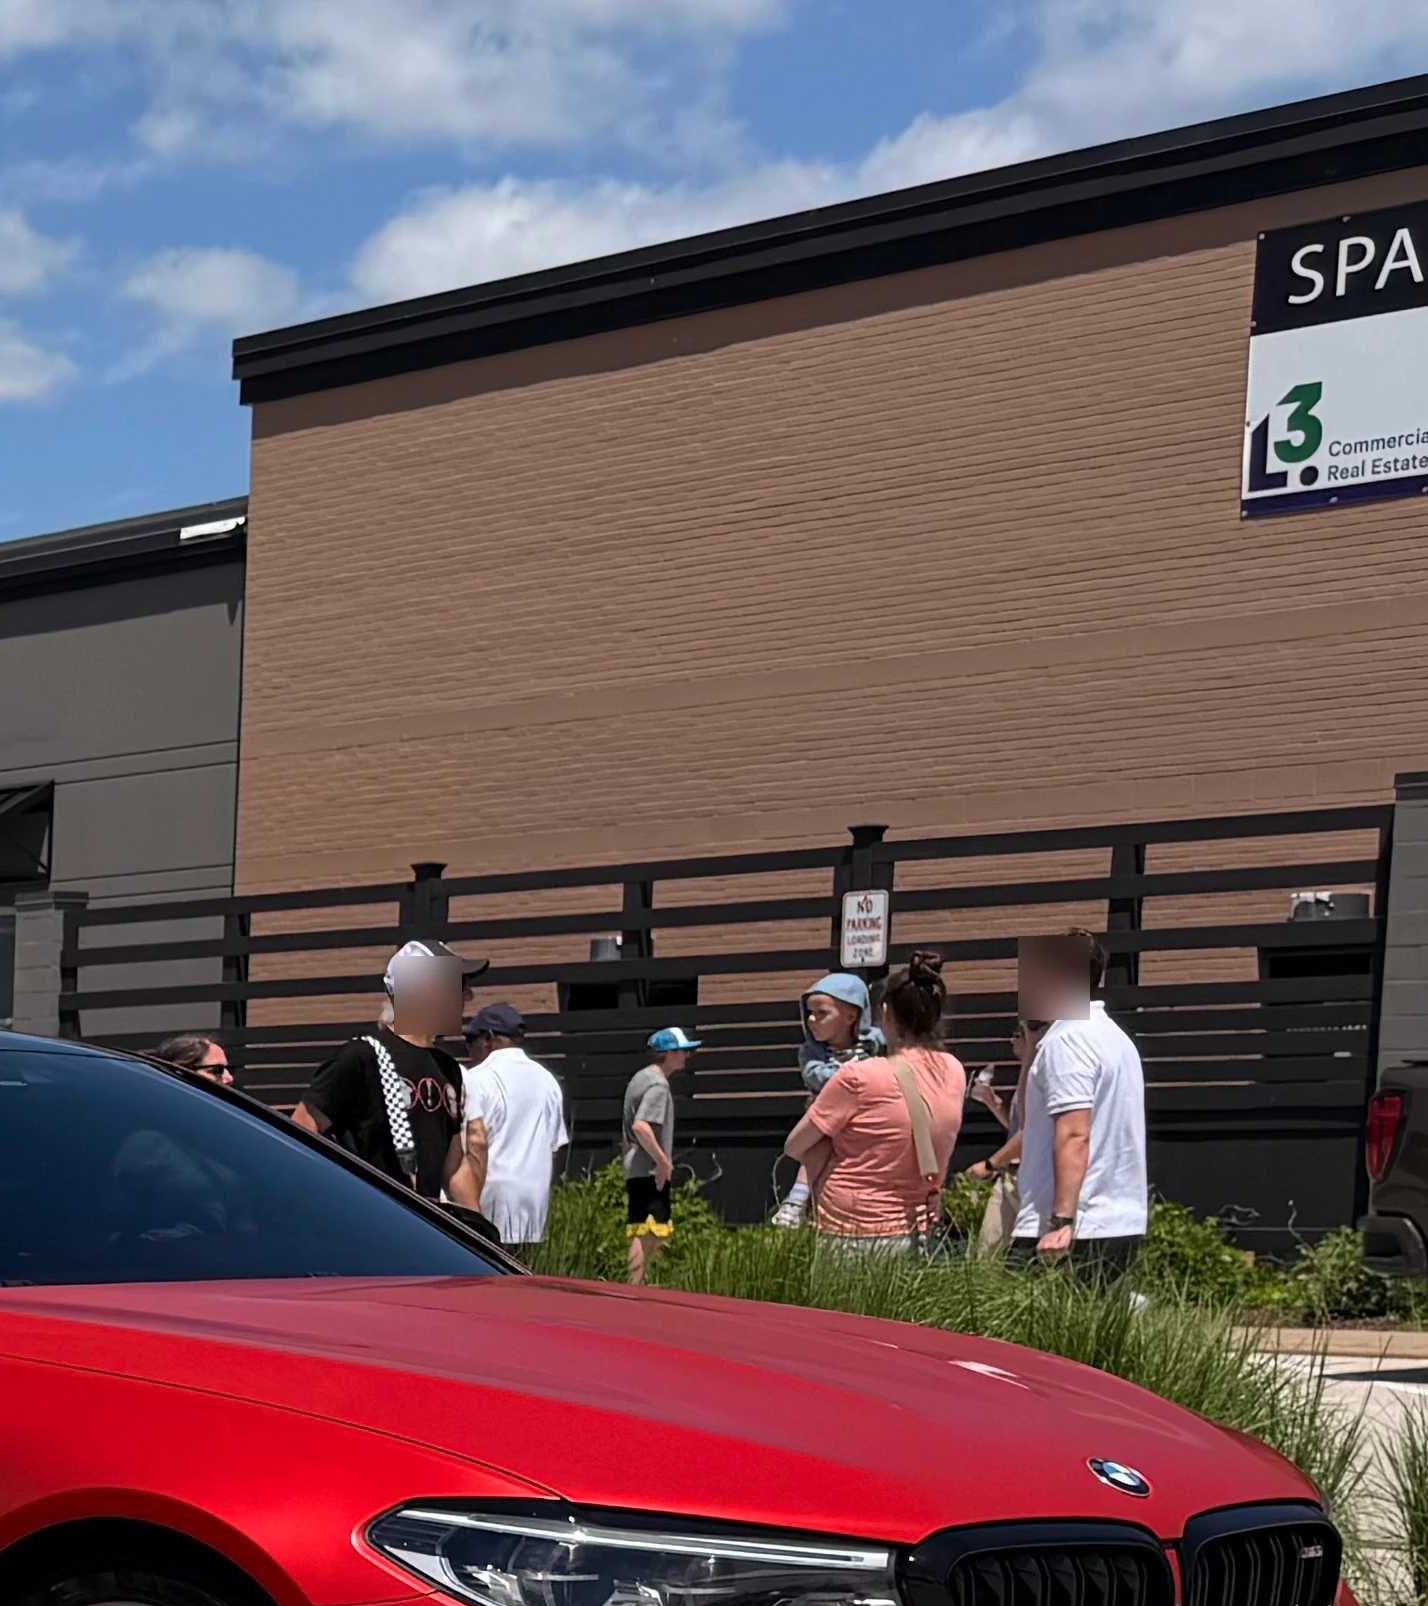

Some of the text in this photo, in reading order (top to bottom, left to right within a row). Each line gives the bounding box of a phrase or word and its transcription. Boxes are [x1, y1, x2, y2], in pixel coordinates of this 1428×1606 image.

[1288, 227, 1424, 304] SPA
[1328, 427, 1428, 457] Commercia
[1327, 454, 1428, 481] Real Estate
[856, 897, 873, 914] NO
[846, 917, 882, 931] PARKING
